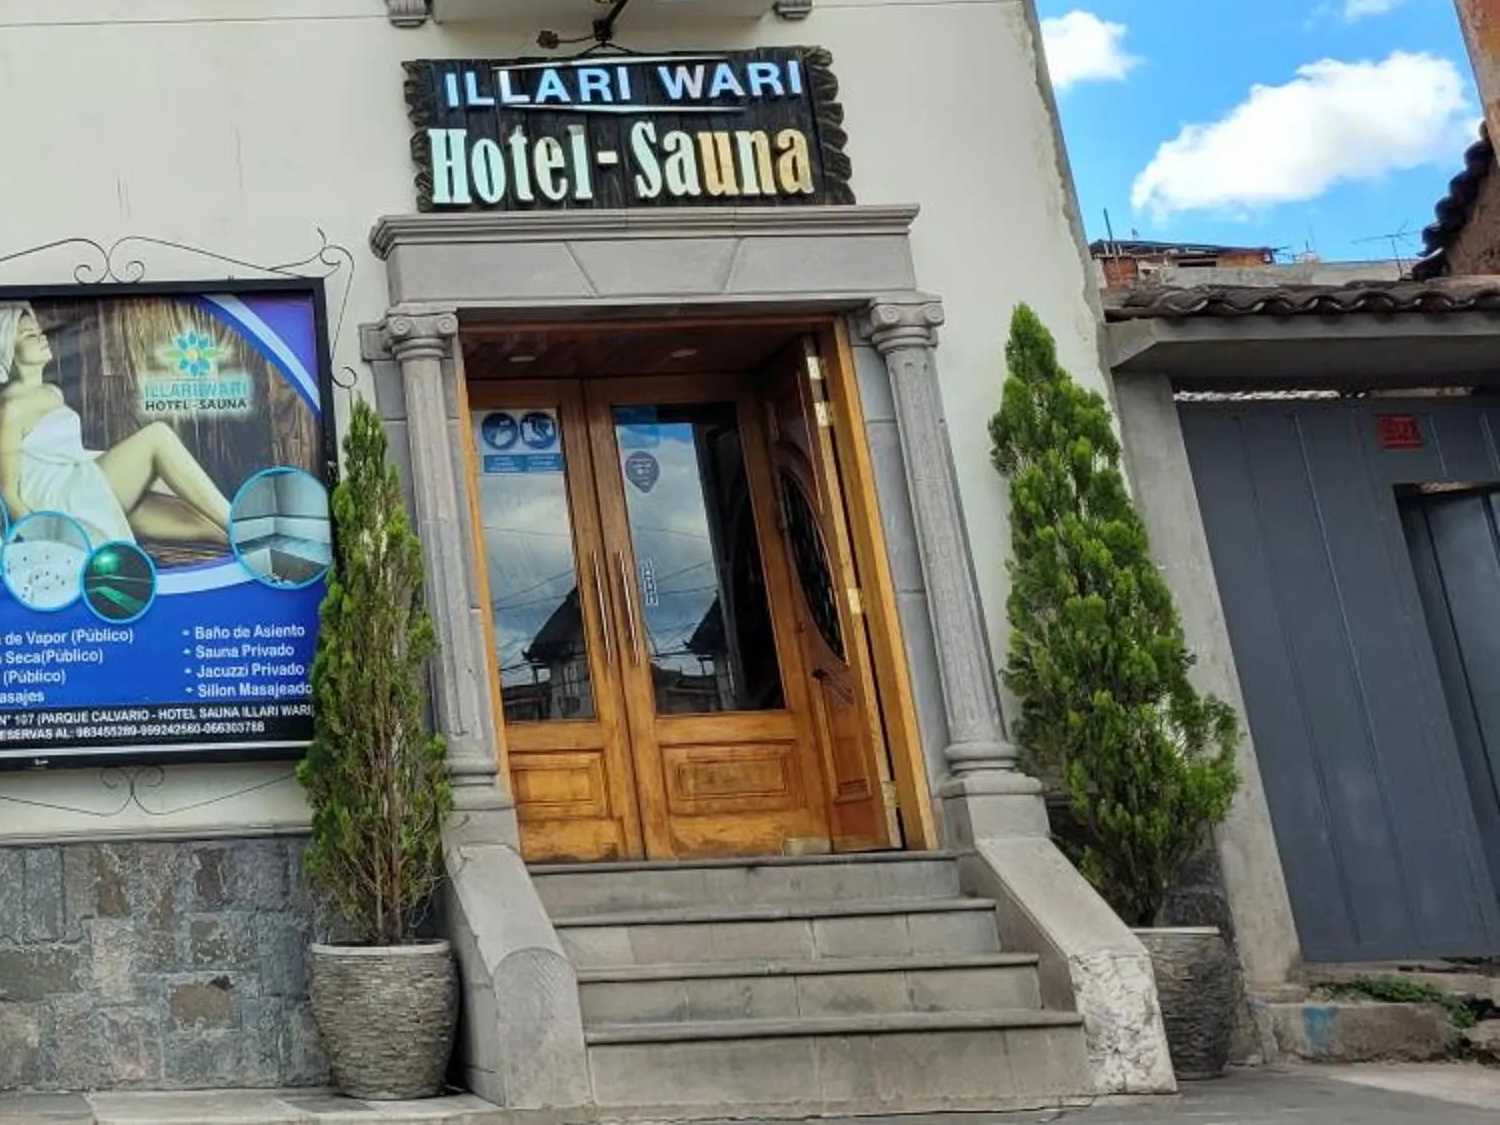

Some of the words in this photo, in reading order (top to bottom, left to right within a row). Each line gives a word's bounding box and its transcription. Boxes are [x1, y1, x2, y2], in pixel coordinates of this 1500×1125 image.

[444, 69, 631, 108] ILLARI
[658, 60, 803, 101] WARI
[145, 381, 197, 397] ILLARI
[199, 380, 247, 396] WARI
[5, 632, 22, 645] de
[26, 631, 68, 647] Vapor
[71, 627, 134, 646] (Público)
[195, 625, 230, 640] Baño
[233, 625, 250, 638] de
[254, 624, 305, 638] Asiento
[195, 645, 239, 659] Sauna
[242, 642, 295, 657] Privado
[3, 669, 67, 687] (Público)
[197, 663, 249, 678] Jacuzzi
[252, 662, 305, 676] Privado
[239, 681, 314, 700] Masajeado
[37, 711, 89, 726] (PARQUE
[91, 709, 150, 723] CALVARIO
[159, 708, 197, 721] HOTEL
[199, 706, 241, 719] SAUNA
[242, 706, 279, 718] ILLARI
